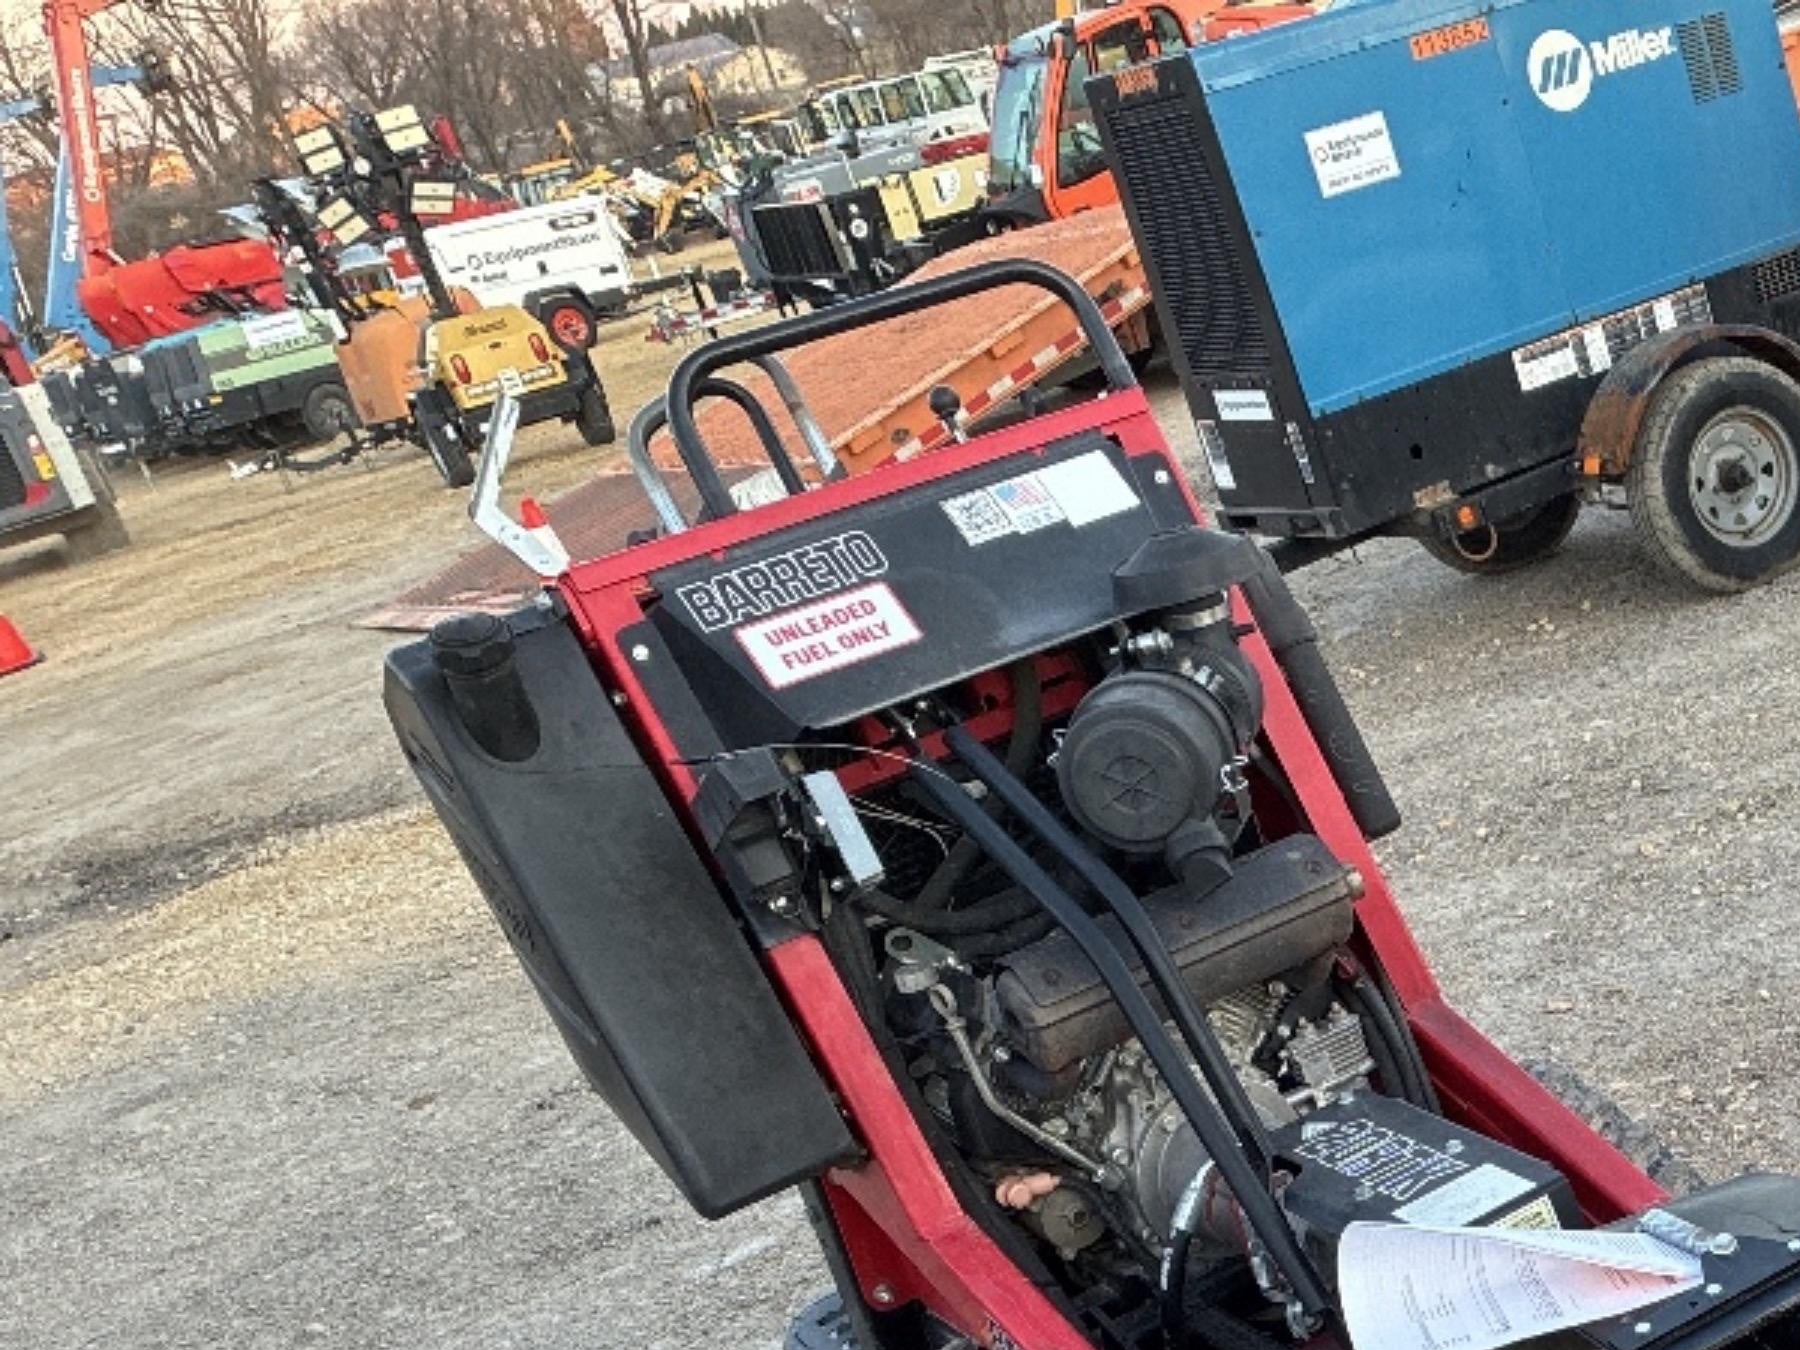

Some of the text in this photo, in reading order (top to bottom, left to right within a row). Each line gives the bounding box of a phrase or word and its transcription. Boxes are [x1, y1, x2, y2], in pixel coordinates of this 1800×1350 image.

[1590, 26, 1673, 76] Miller
[675, 530, 889, 634] BARRETO
[764, 598, 877, 647] UNLEADED
[780, 619, 892, 670] FUEL ONLY
